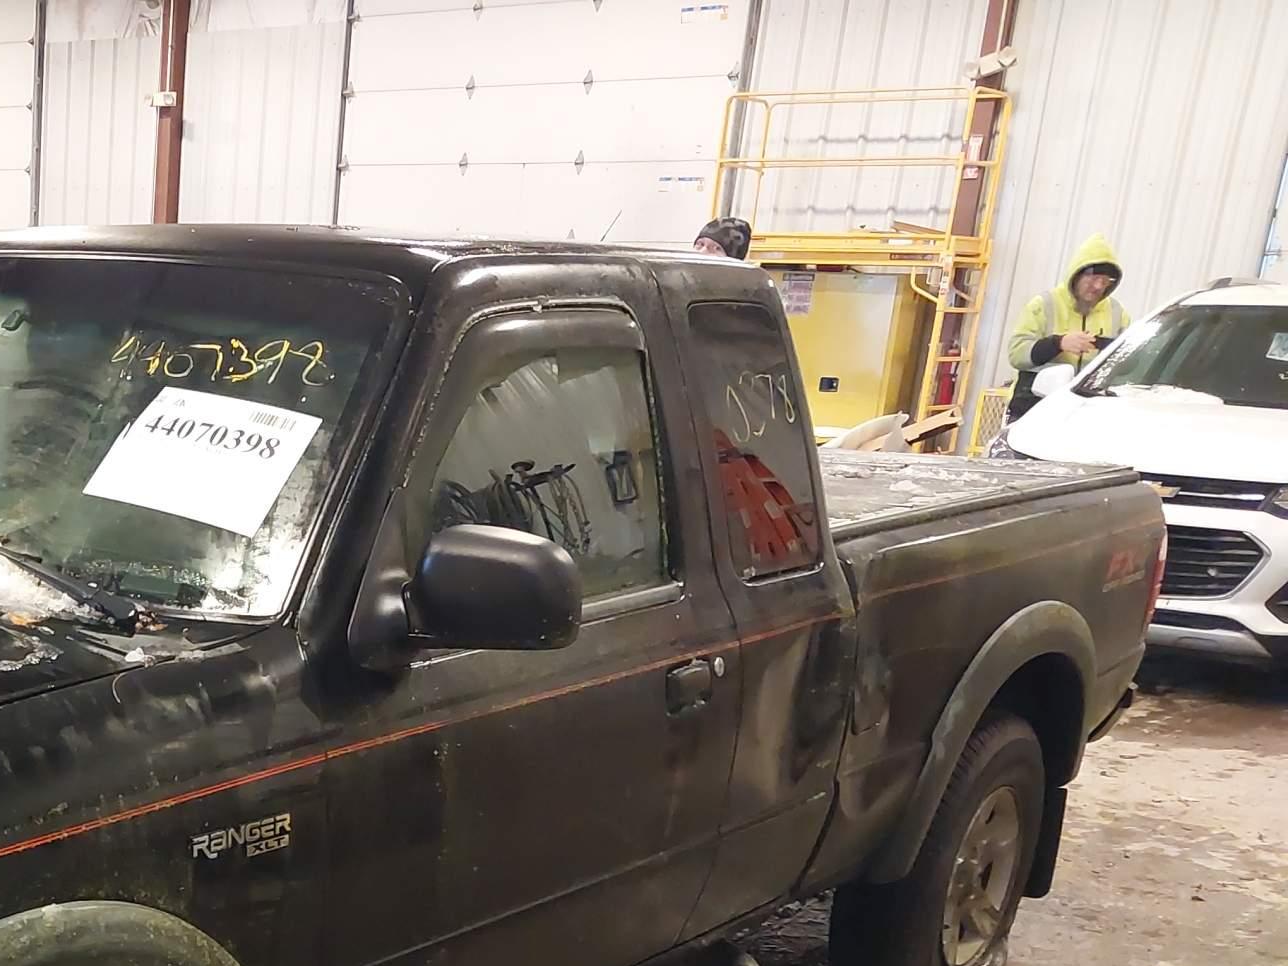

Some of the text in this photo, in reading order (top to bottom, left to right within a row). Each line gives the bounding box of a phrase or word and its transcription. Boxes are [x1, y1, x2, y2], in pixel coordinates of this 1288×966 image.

[144, 414, 281, 460] 44070398
[191, 813, 292, 859] RANGER
[249, 835, 288, 856] XLT
